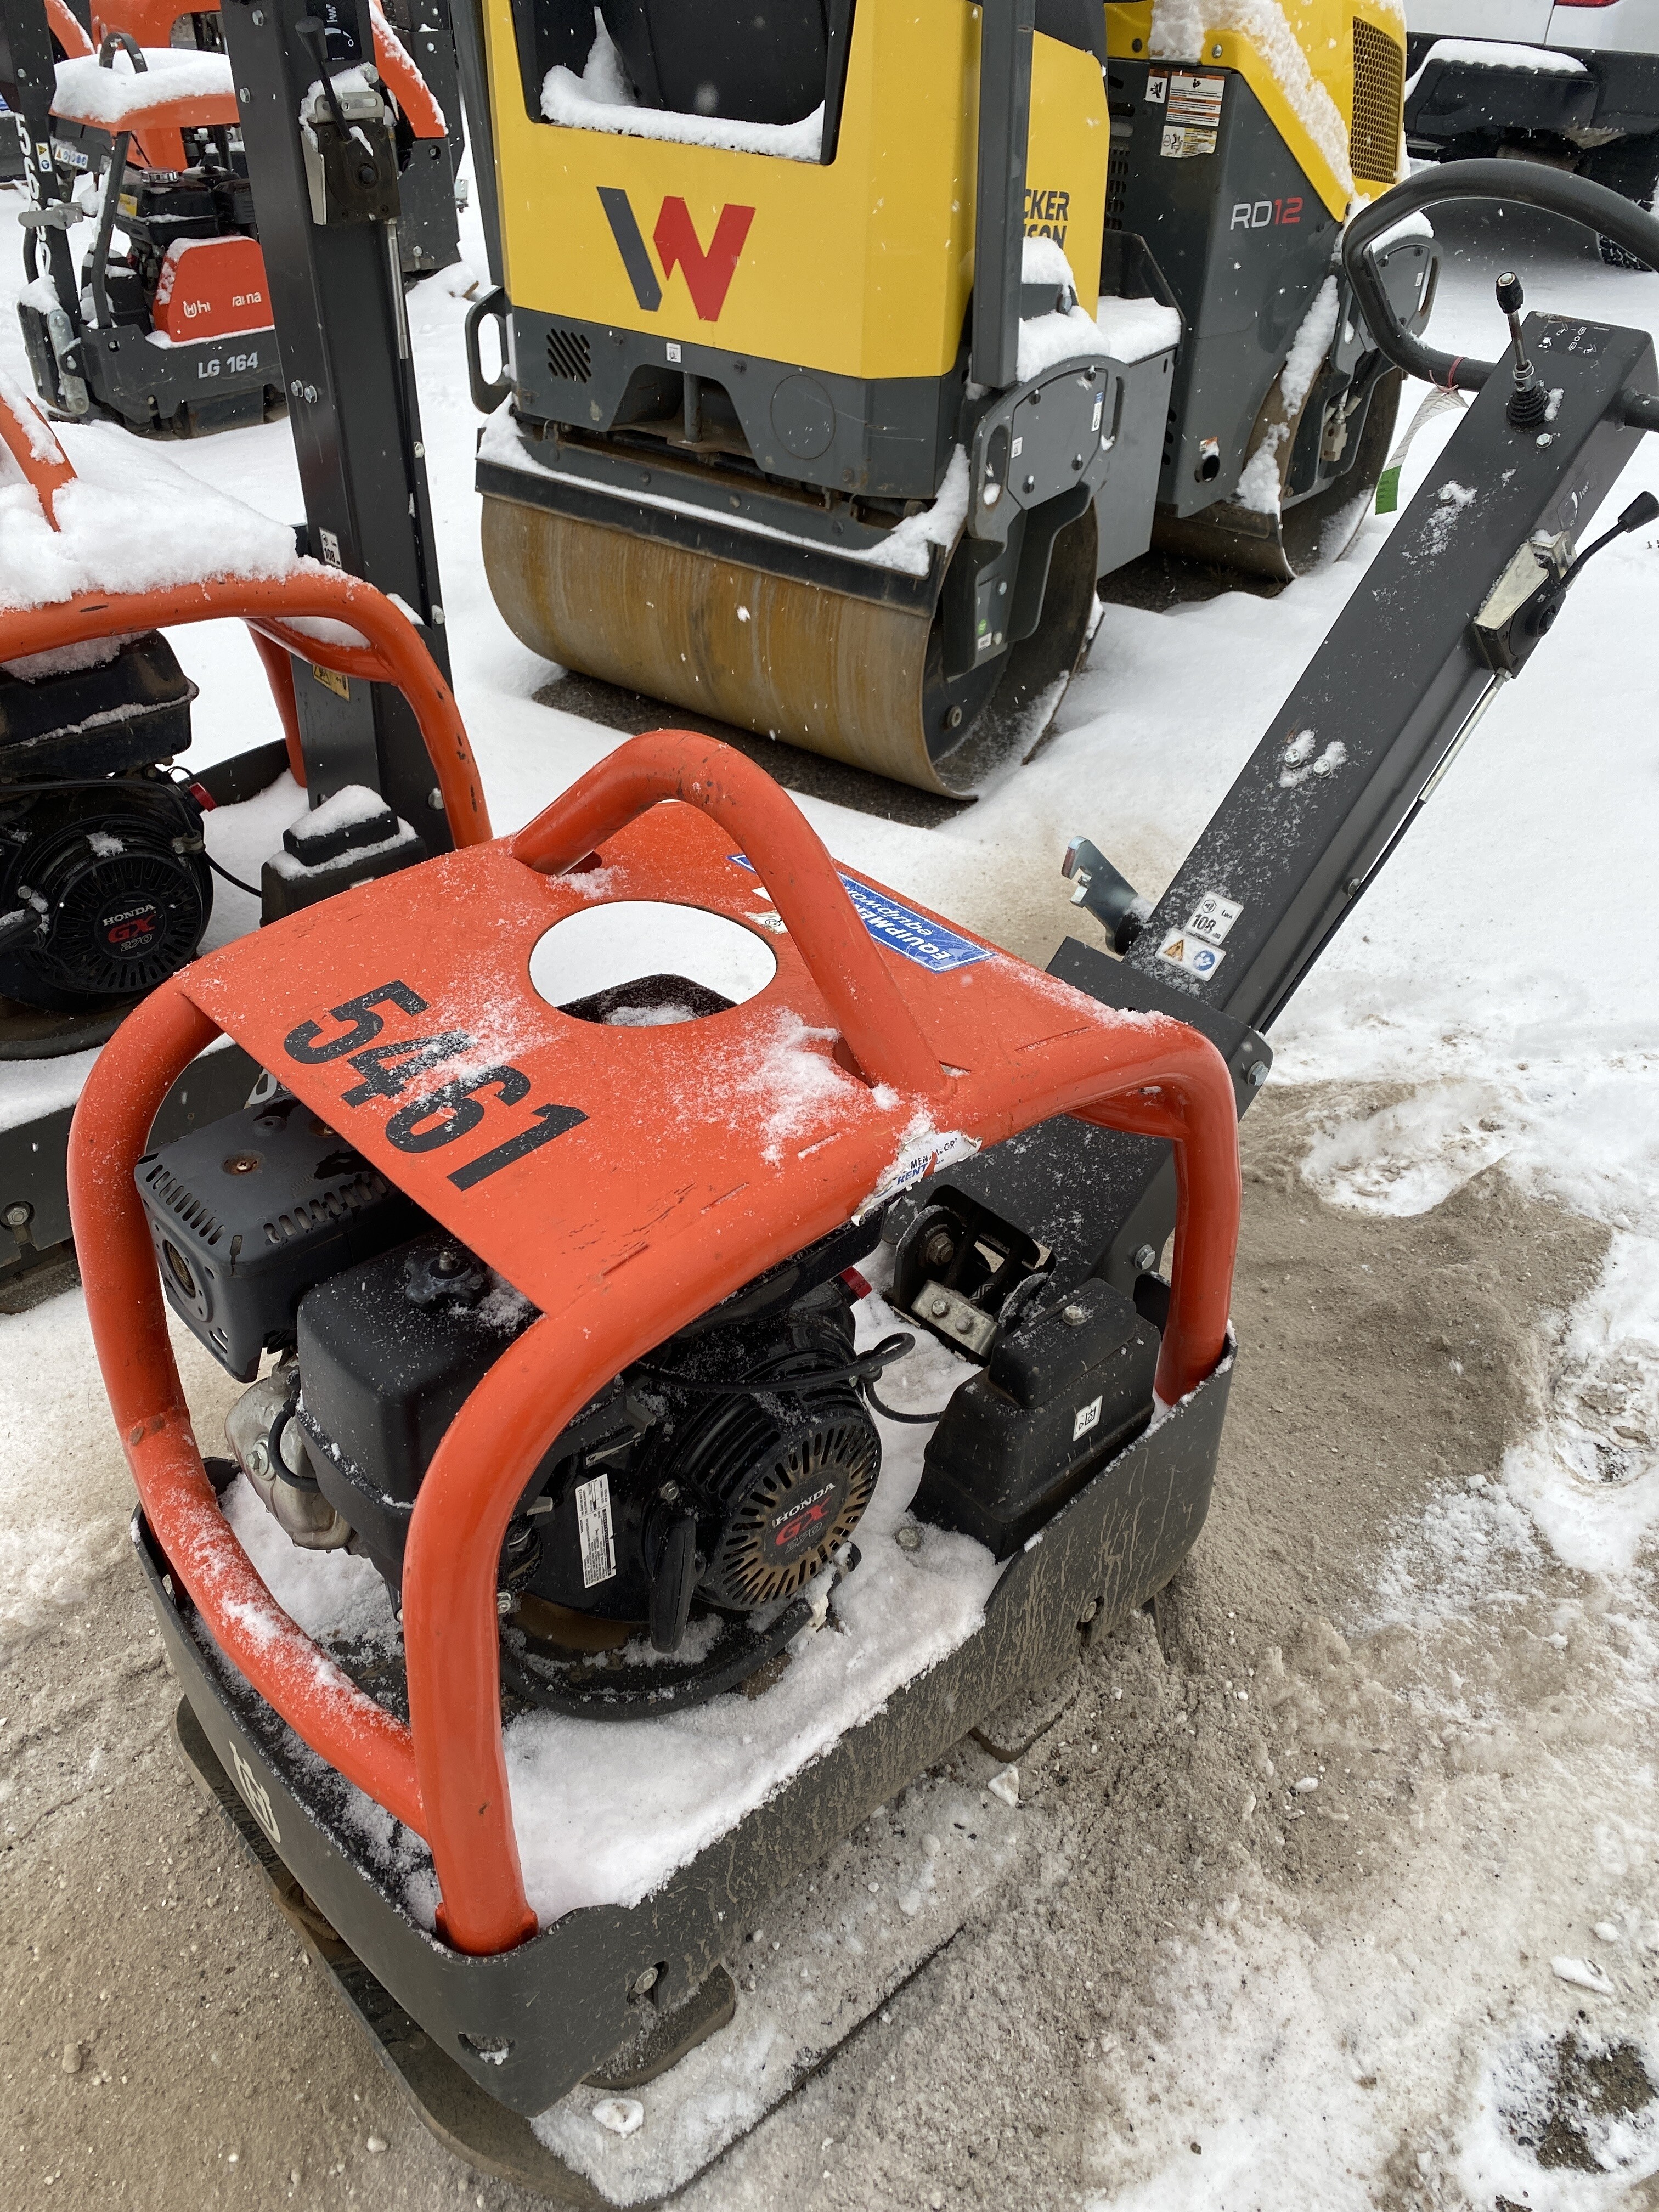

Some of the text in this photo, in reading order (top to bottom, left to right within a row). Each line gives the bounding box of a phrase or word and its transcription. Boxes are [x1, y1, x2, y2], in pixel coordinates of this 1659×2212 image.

[1024, 189, 1070, 221] CKER
[1230, 196, 1304, 230] RD12
[596, 186, 756, 321] W
[198, 352, 258, 379] LG 164
[102, 904, 156, 926] HONDA
[845, 885, 933, 936] equipwor
[1192, 913, 1216, 933] 108
[108, 915, 157, 943] GX
[121, 934, 153, 952] 270
[854, 903, 952, 961] EQUIPMEN
[283, 979, 590, 1192] 5461
[775, 1483, 836, 1526] HONDA
[775, 1495, 832, 1546] GX
[785, 1522, 822, 1554] 270
